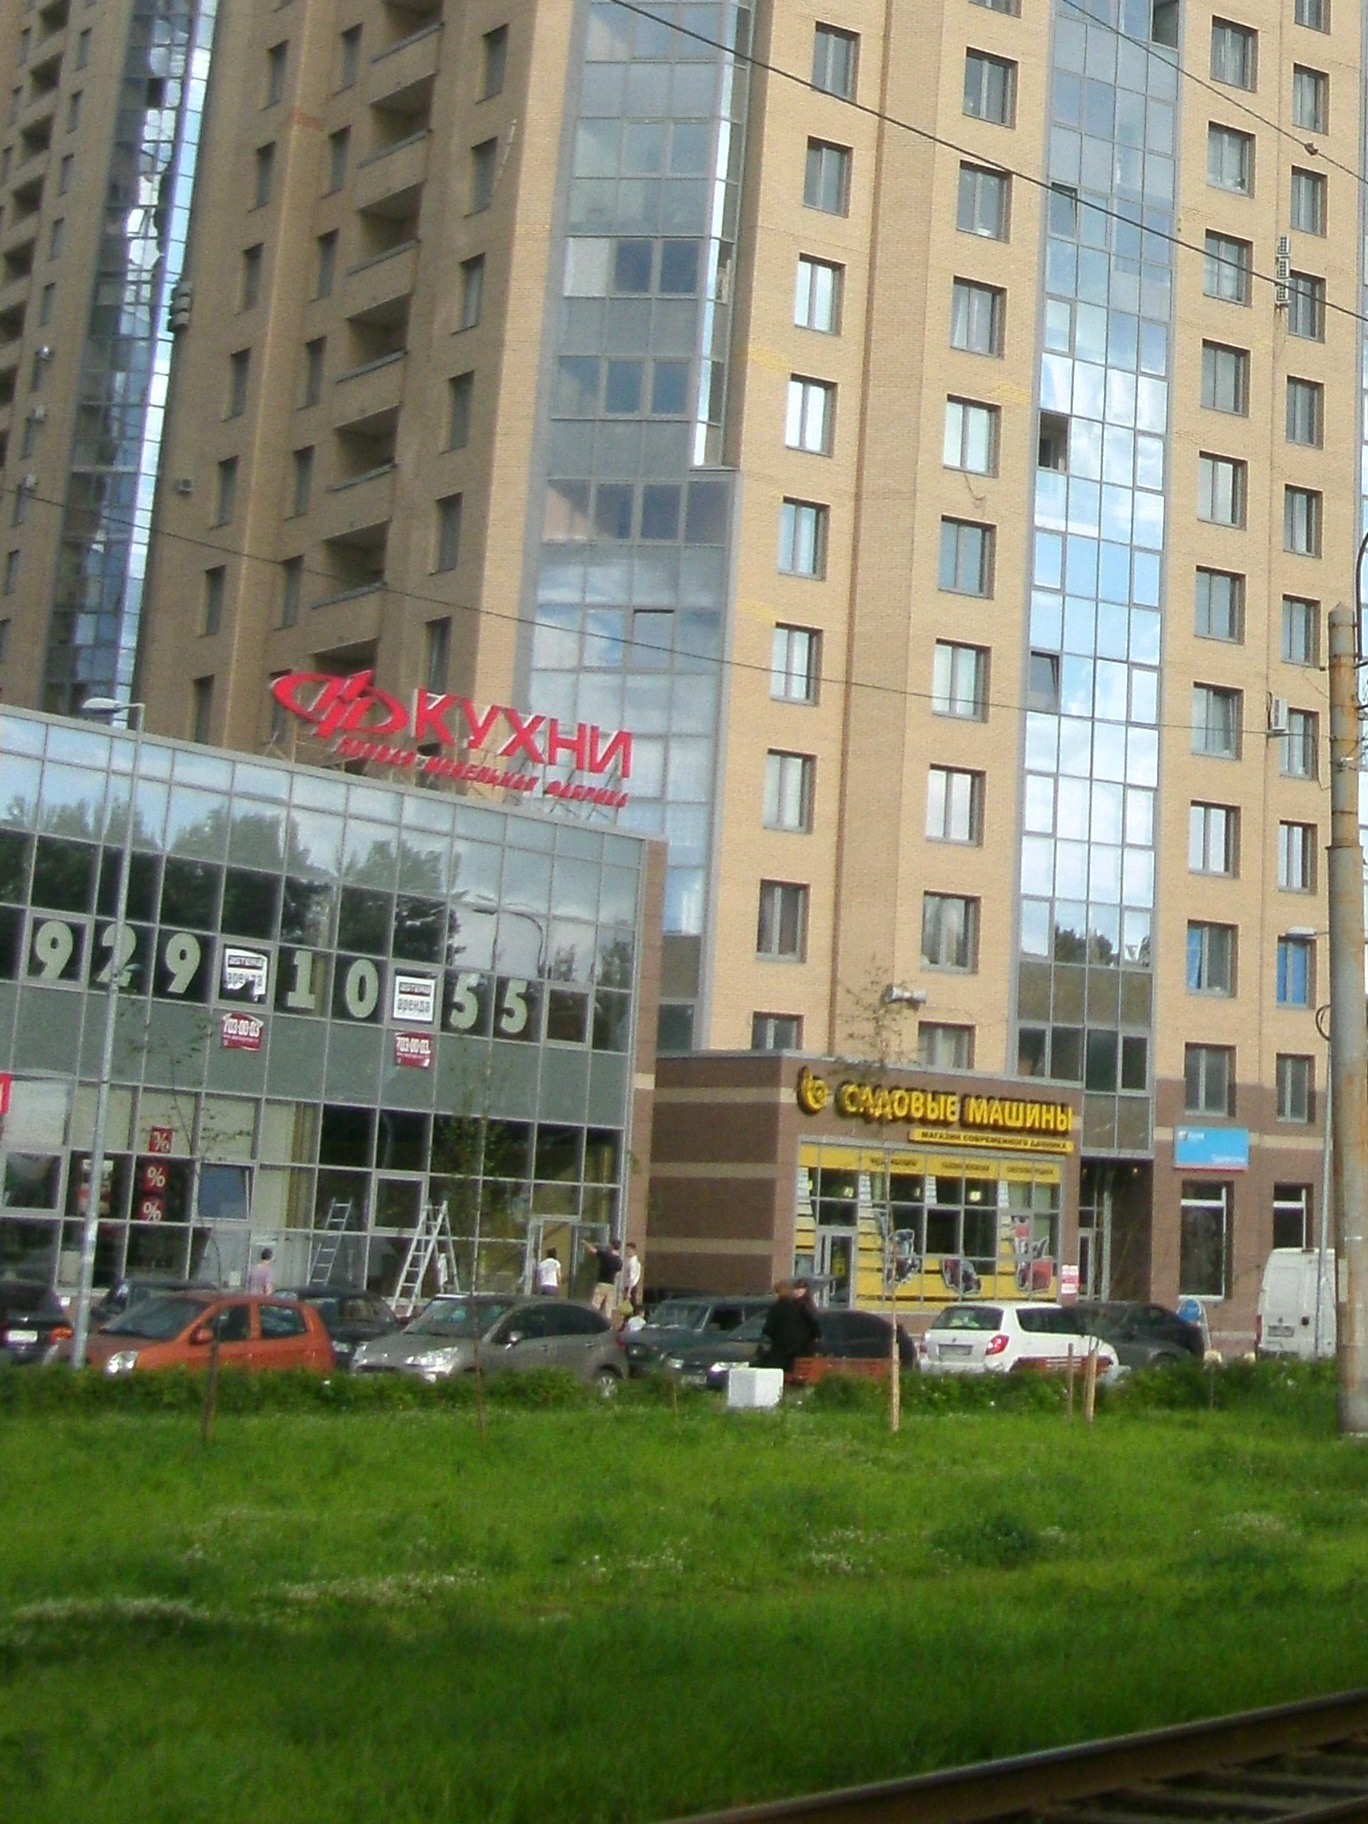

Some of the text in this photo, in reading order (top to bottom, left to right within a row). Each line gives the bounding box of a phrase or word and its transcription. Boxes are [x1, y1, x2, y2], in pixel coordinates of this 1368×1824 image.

[412, 687, 632, 779] КУХНИ
[35, 919, 528, 1034] 929 10 55
[397, 997, 431, 1013] аренда
[836, 1082, 1073, 1134] САДОВЫЕ МАШИНЫ
[920, 1130, 961, 1142] МАГАЗИН
[963, 1134, 1028, 1147] СОВРЕМЕННОГО
